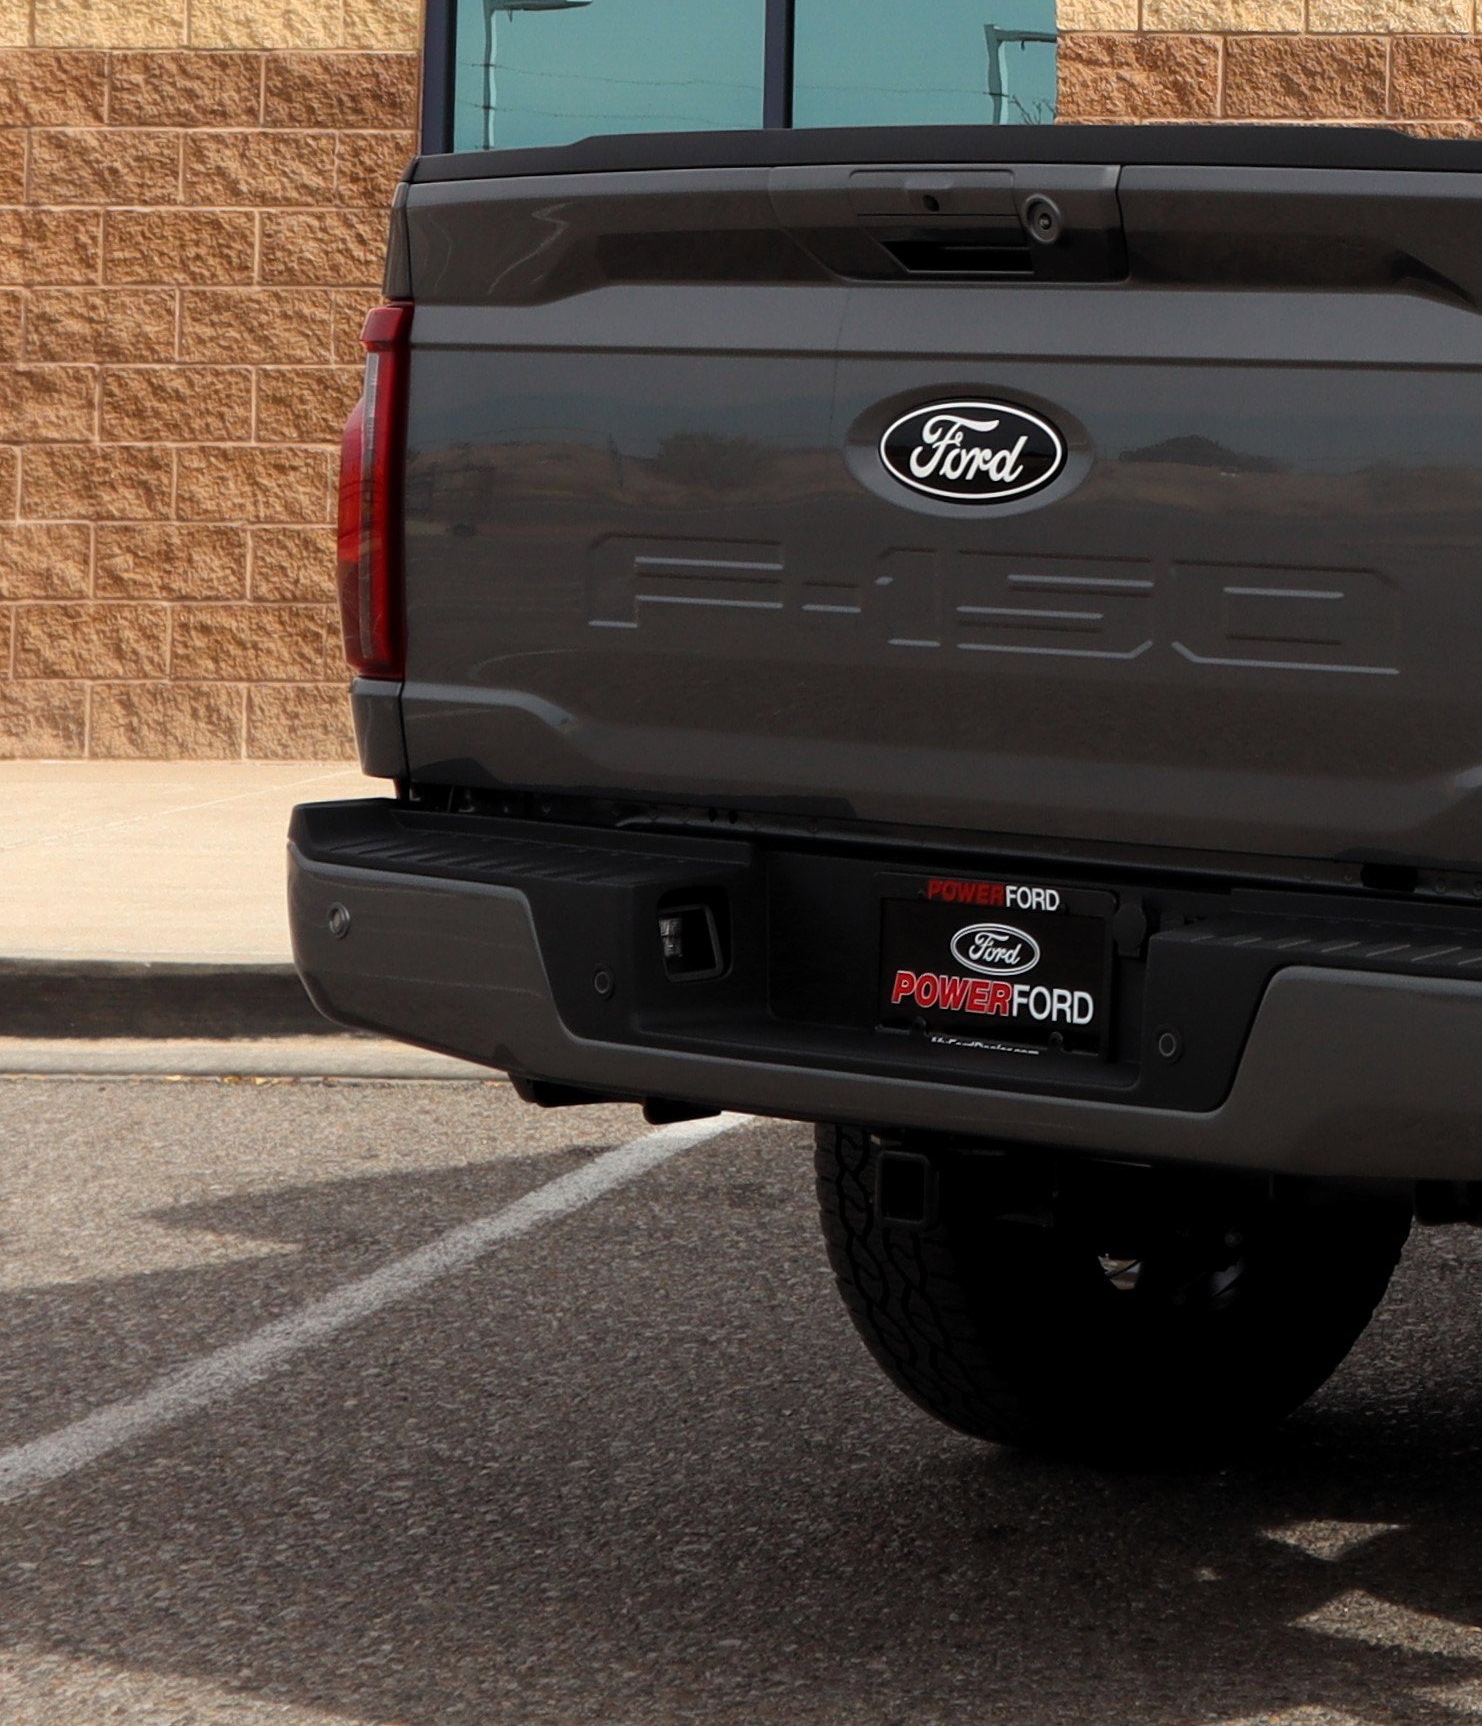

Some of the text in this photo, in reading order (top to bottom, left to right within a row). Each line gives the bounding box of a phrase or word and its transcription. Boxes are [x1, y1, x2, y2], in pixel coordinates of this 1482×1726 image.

[909, 413, 1029, 483] Ford
[588, 531, 1401, 677] F-150
[926, 879, 1061, 911] POWERFORD
[968, 931, 1022, 965] Ford
[891, 970, 1095, 1025] POWERFORD
